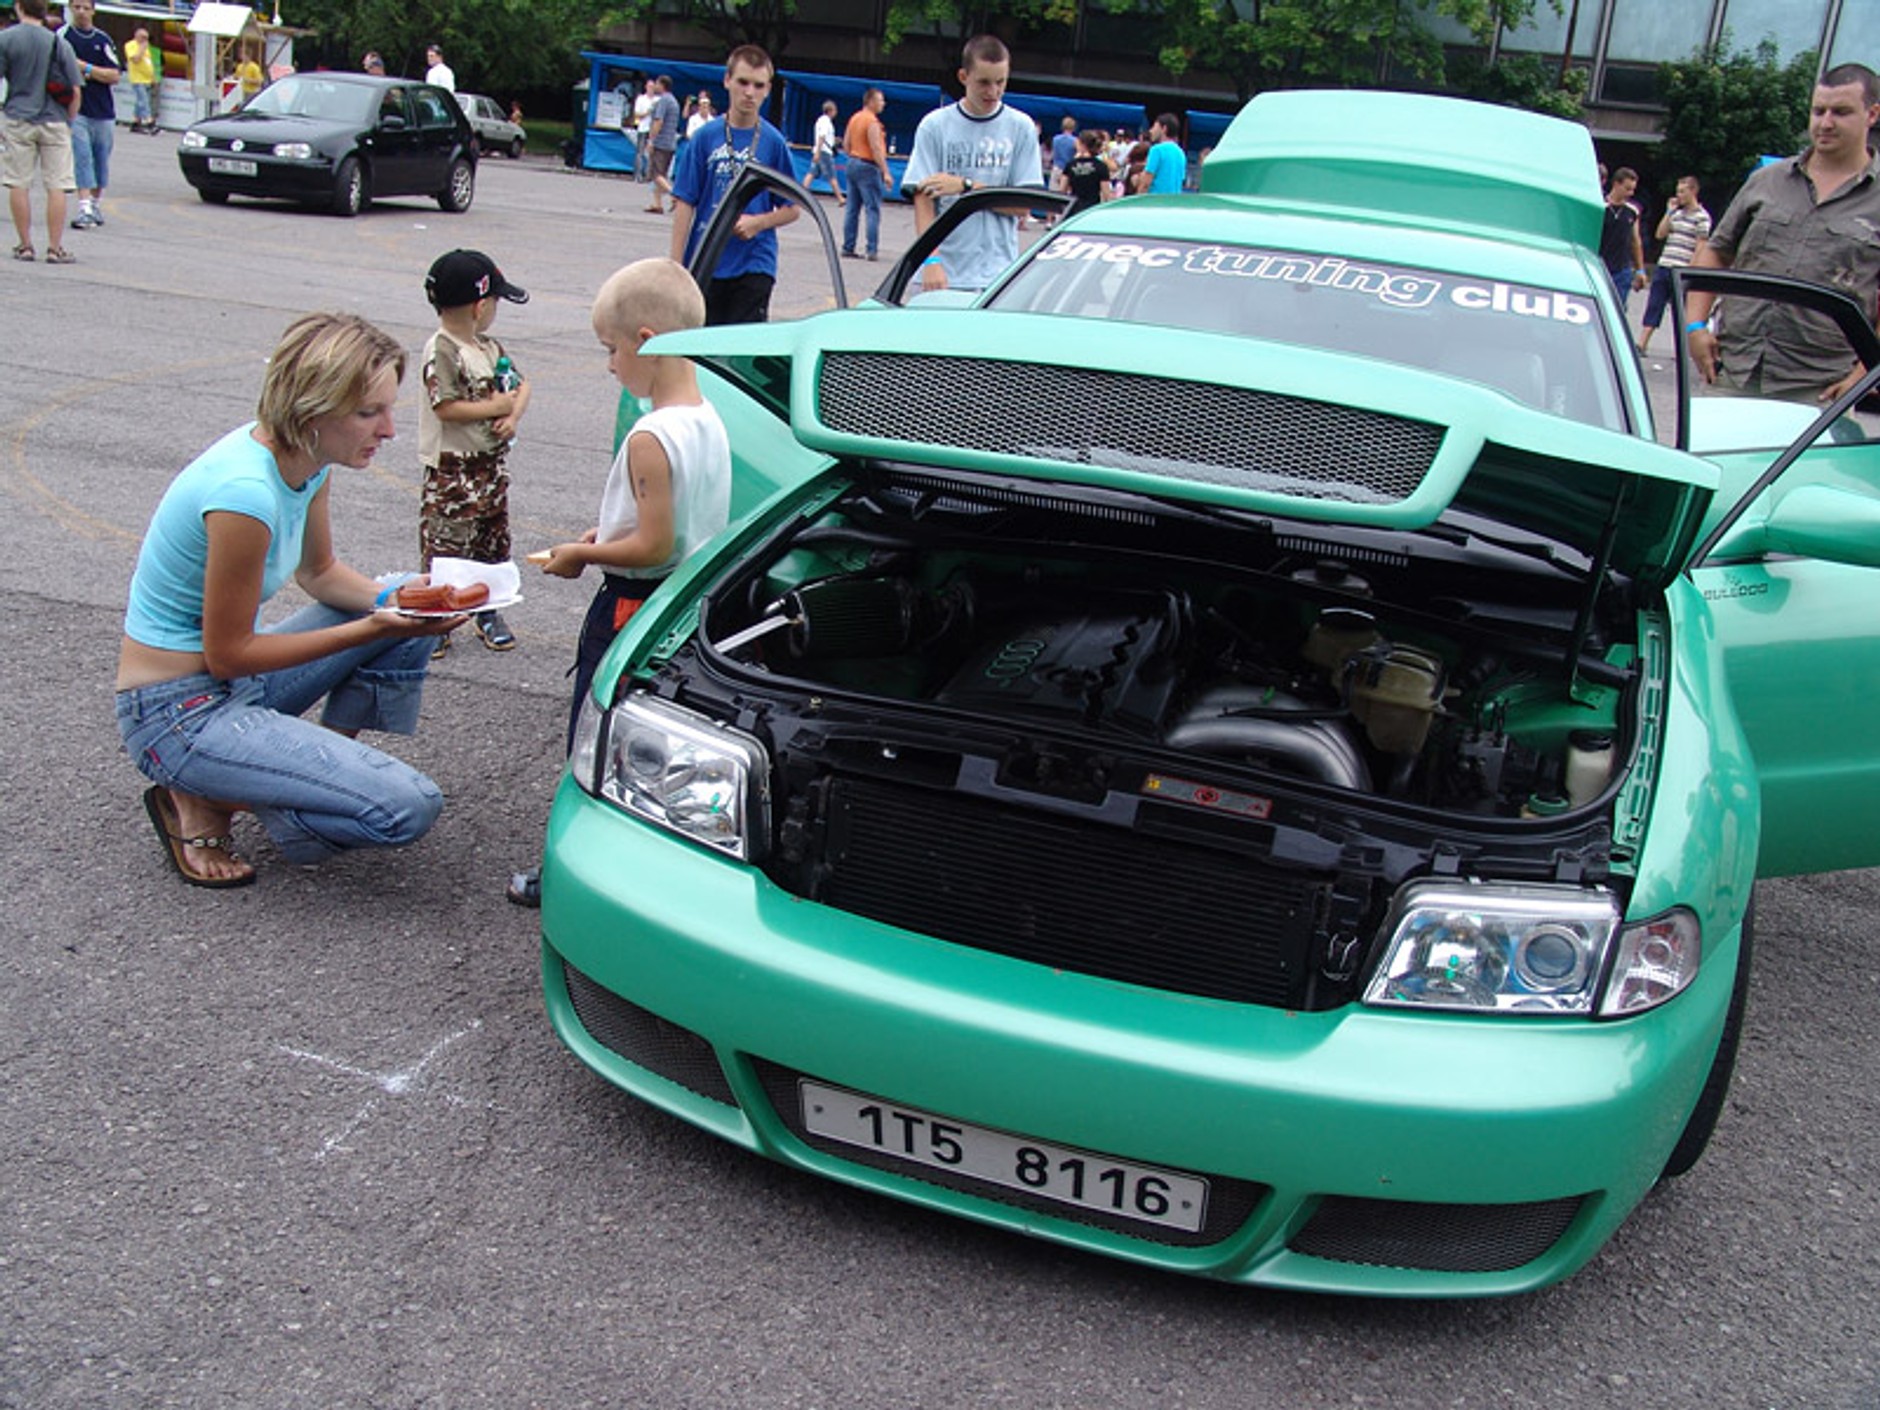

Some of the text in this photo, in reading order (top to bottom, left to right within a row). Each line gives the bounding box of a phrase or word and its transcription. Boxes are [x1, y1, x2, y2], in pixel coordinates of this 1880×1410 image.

[1183, 246, 1441, 308] tuning
[1451, 282, 1591, 325] club
[858, 1104, 1171, 1216] 1T5 8116
